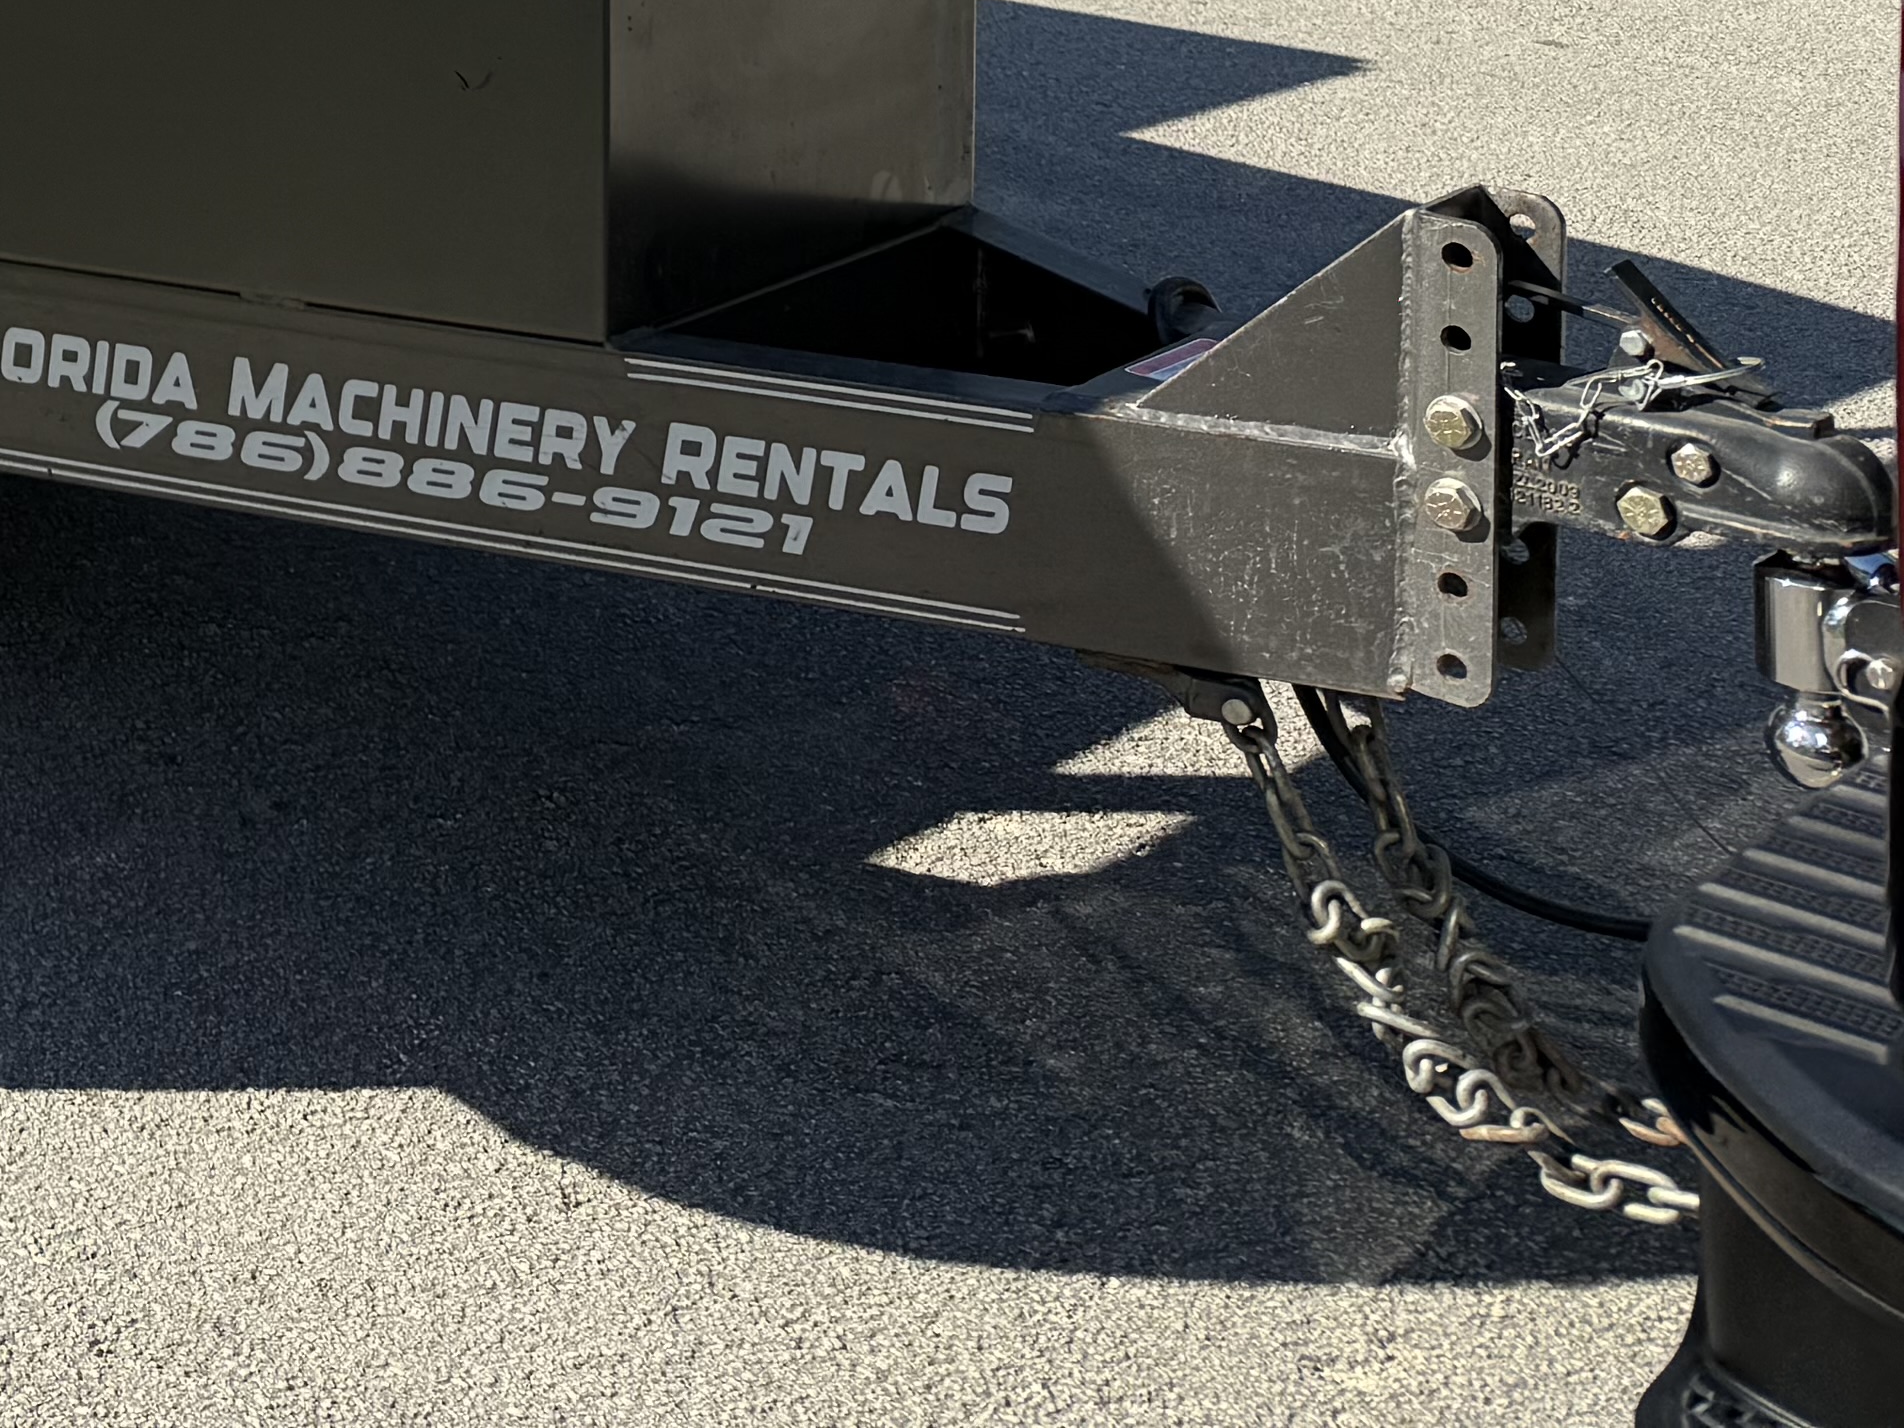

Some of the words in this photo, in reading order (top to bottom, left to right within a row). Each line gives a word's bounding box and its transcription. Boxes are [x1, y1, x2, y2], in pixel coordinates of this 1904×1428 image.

[95, 399, 814, 556] (786)886-9121
[227, 356, 637, 476] MACHINERY
[661, 421, 1013, 535] RENTALS
